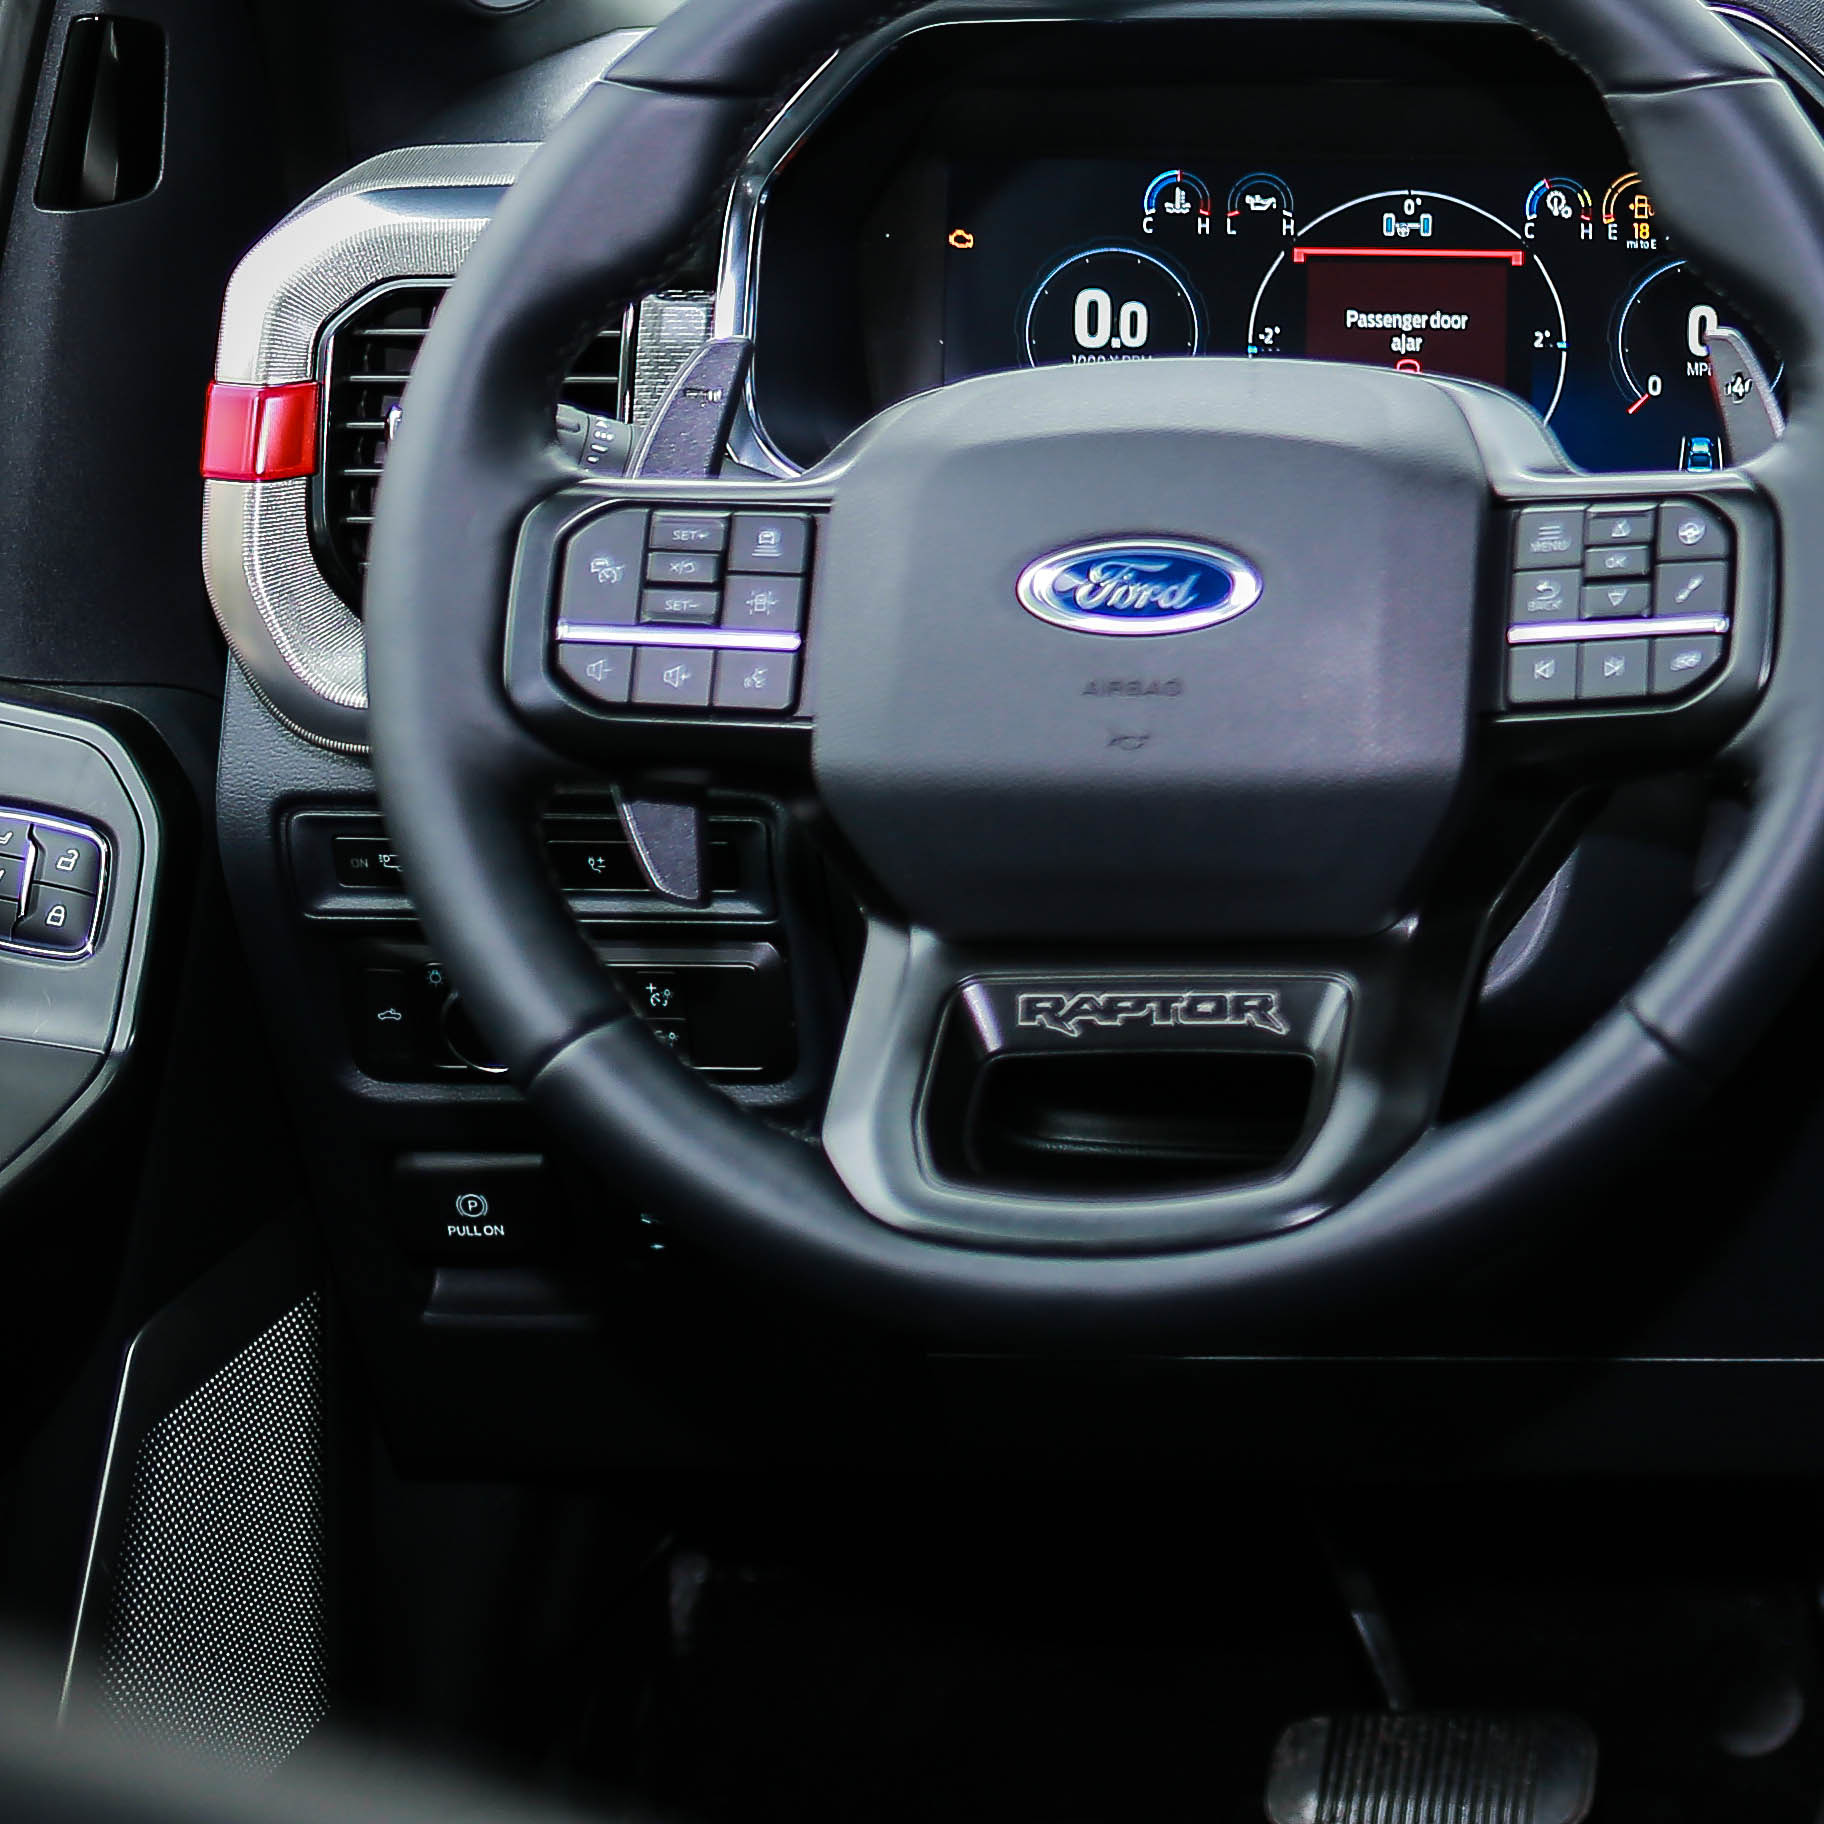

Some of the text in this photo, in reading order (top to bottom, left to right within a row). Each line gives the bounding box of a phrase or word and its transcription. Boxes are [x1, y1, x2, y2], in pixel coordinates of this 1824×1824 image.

[1142, 216, 1154, 234] C
[1197, 217, 1210, 235] H
[1226, 217, 1237, 235] L
[1282, 218, 1295, 236] H
[1524, 222, 1535, 239] C
[1580, 223, 1593, 240] H
[1607, 223, 1618, 241] E
[1632, 222, 1650, 240] 18
[1074, 287, 1148, 349] 0.0
[1345, 309, 1469, 332] Passenger door
[1390, 333, 1423, 355] ajar
[1647, 374, 1662, 396] 0
[1530, 540, 1572, 553] MENU
[1604, 555, 1627, 569] OK
[1054, 560, 1201, 610] Ford
[1080, 677, 1184, 697] AIRBAG
[1016, 991, 1291, 1039] RAPTOR
[447, 1224, 505, 1237] PULL ON
